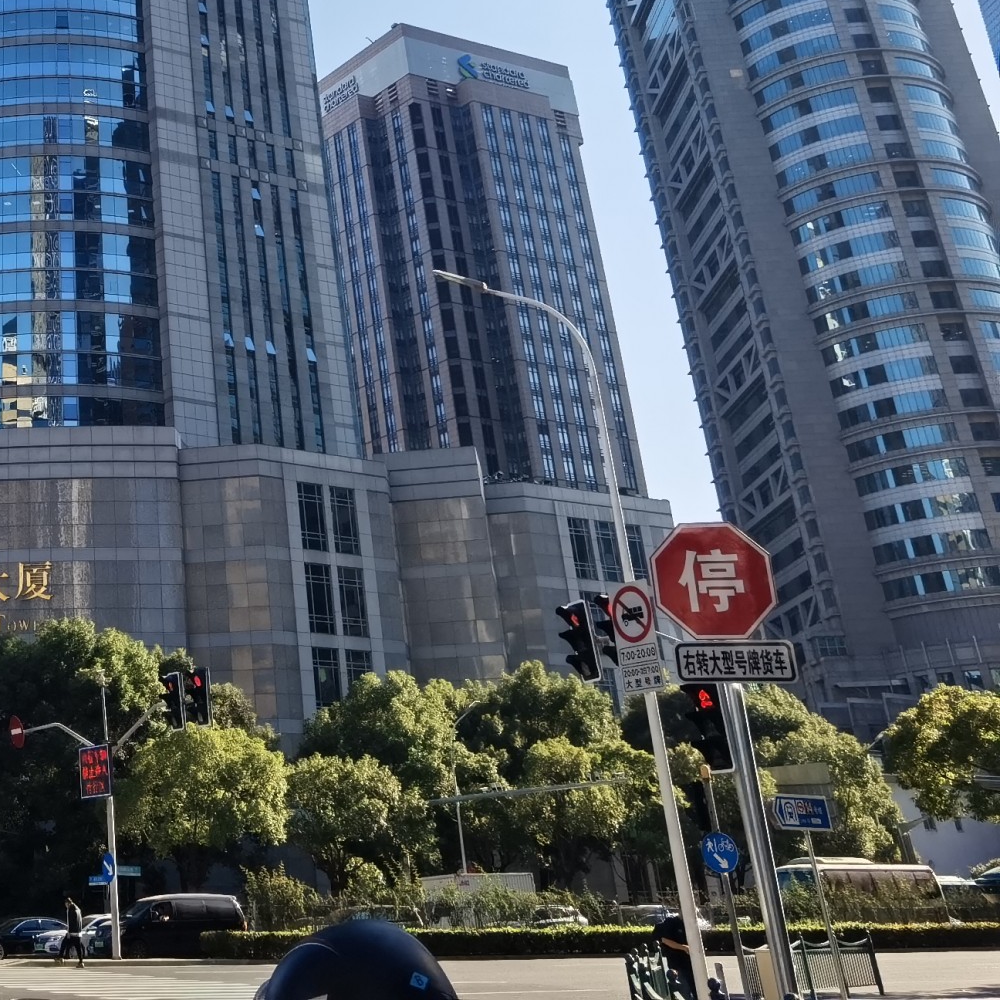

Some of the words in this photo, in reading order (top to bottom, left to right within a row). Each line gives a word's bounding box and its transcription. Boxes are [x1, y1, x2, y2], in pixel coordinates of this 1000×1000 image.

[481, 62, 526, 79] standard
[483, 71, 530, 89] chartered
[679, 548, 745, 613] 停
[683, 649, 788, 676] 右转大型号牌货车
